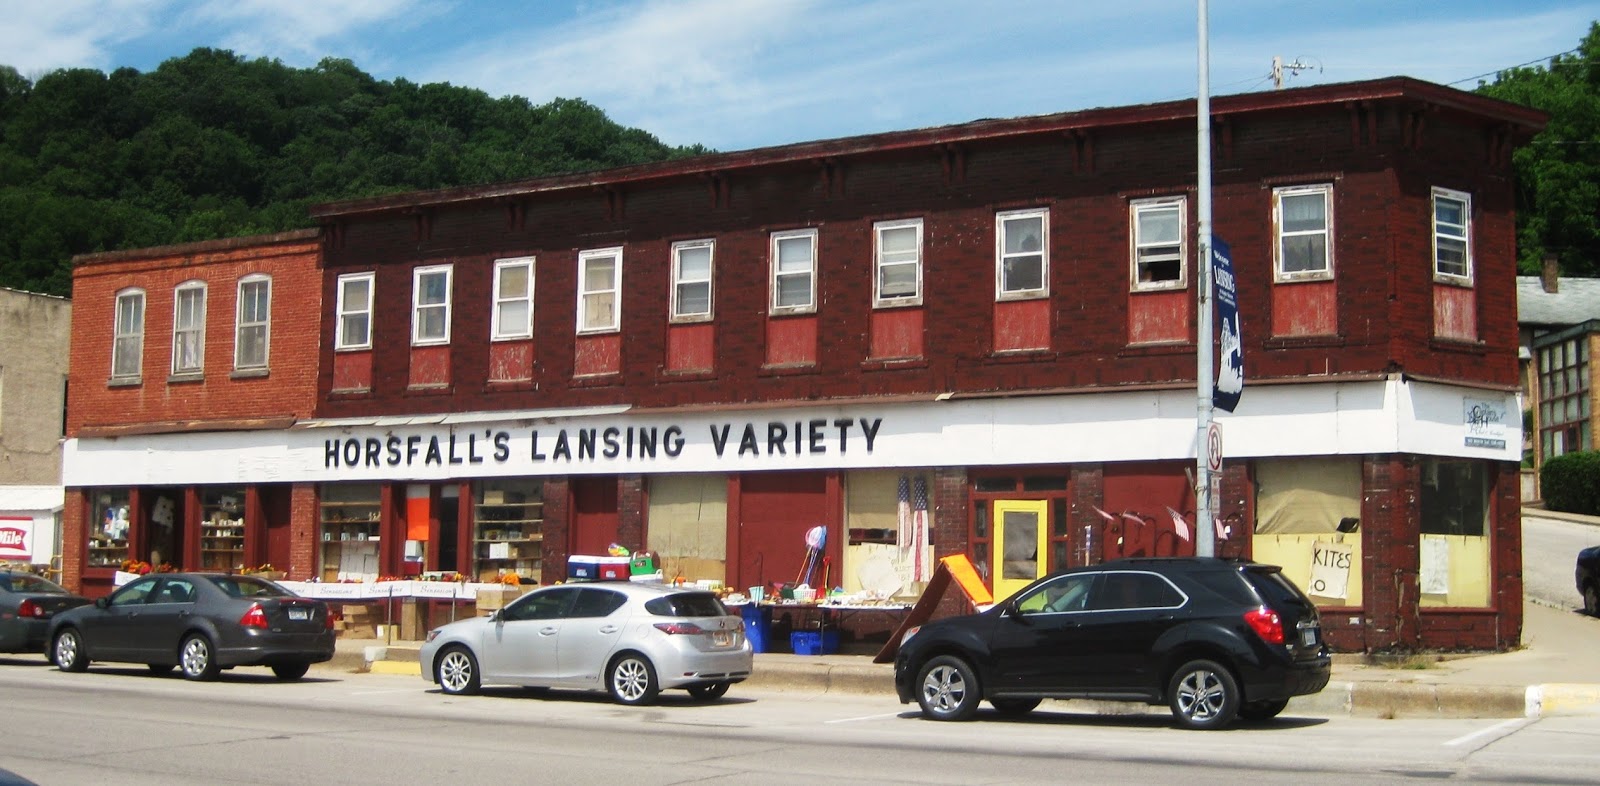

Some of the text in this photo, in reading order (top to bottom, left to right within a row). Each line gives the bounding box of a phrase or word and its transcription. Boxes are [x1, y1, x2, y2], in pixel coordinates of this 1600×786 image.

[325, 418, 882, 467] HORSFALL'S LANSING VARIETY
[1313, 548, 1351, 569] KITES
[368, 585, 403, 594] Sensatons
[420, 585, 454, 594] Sensation
